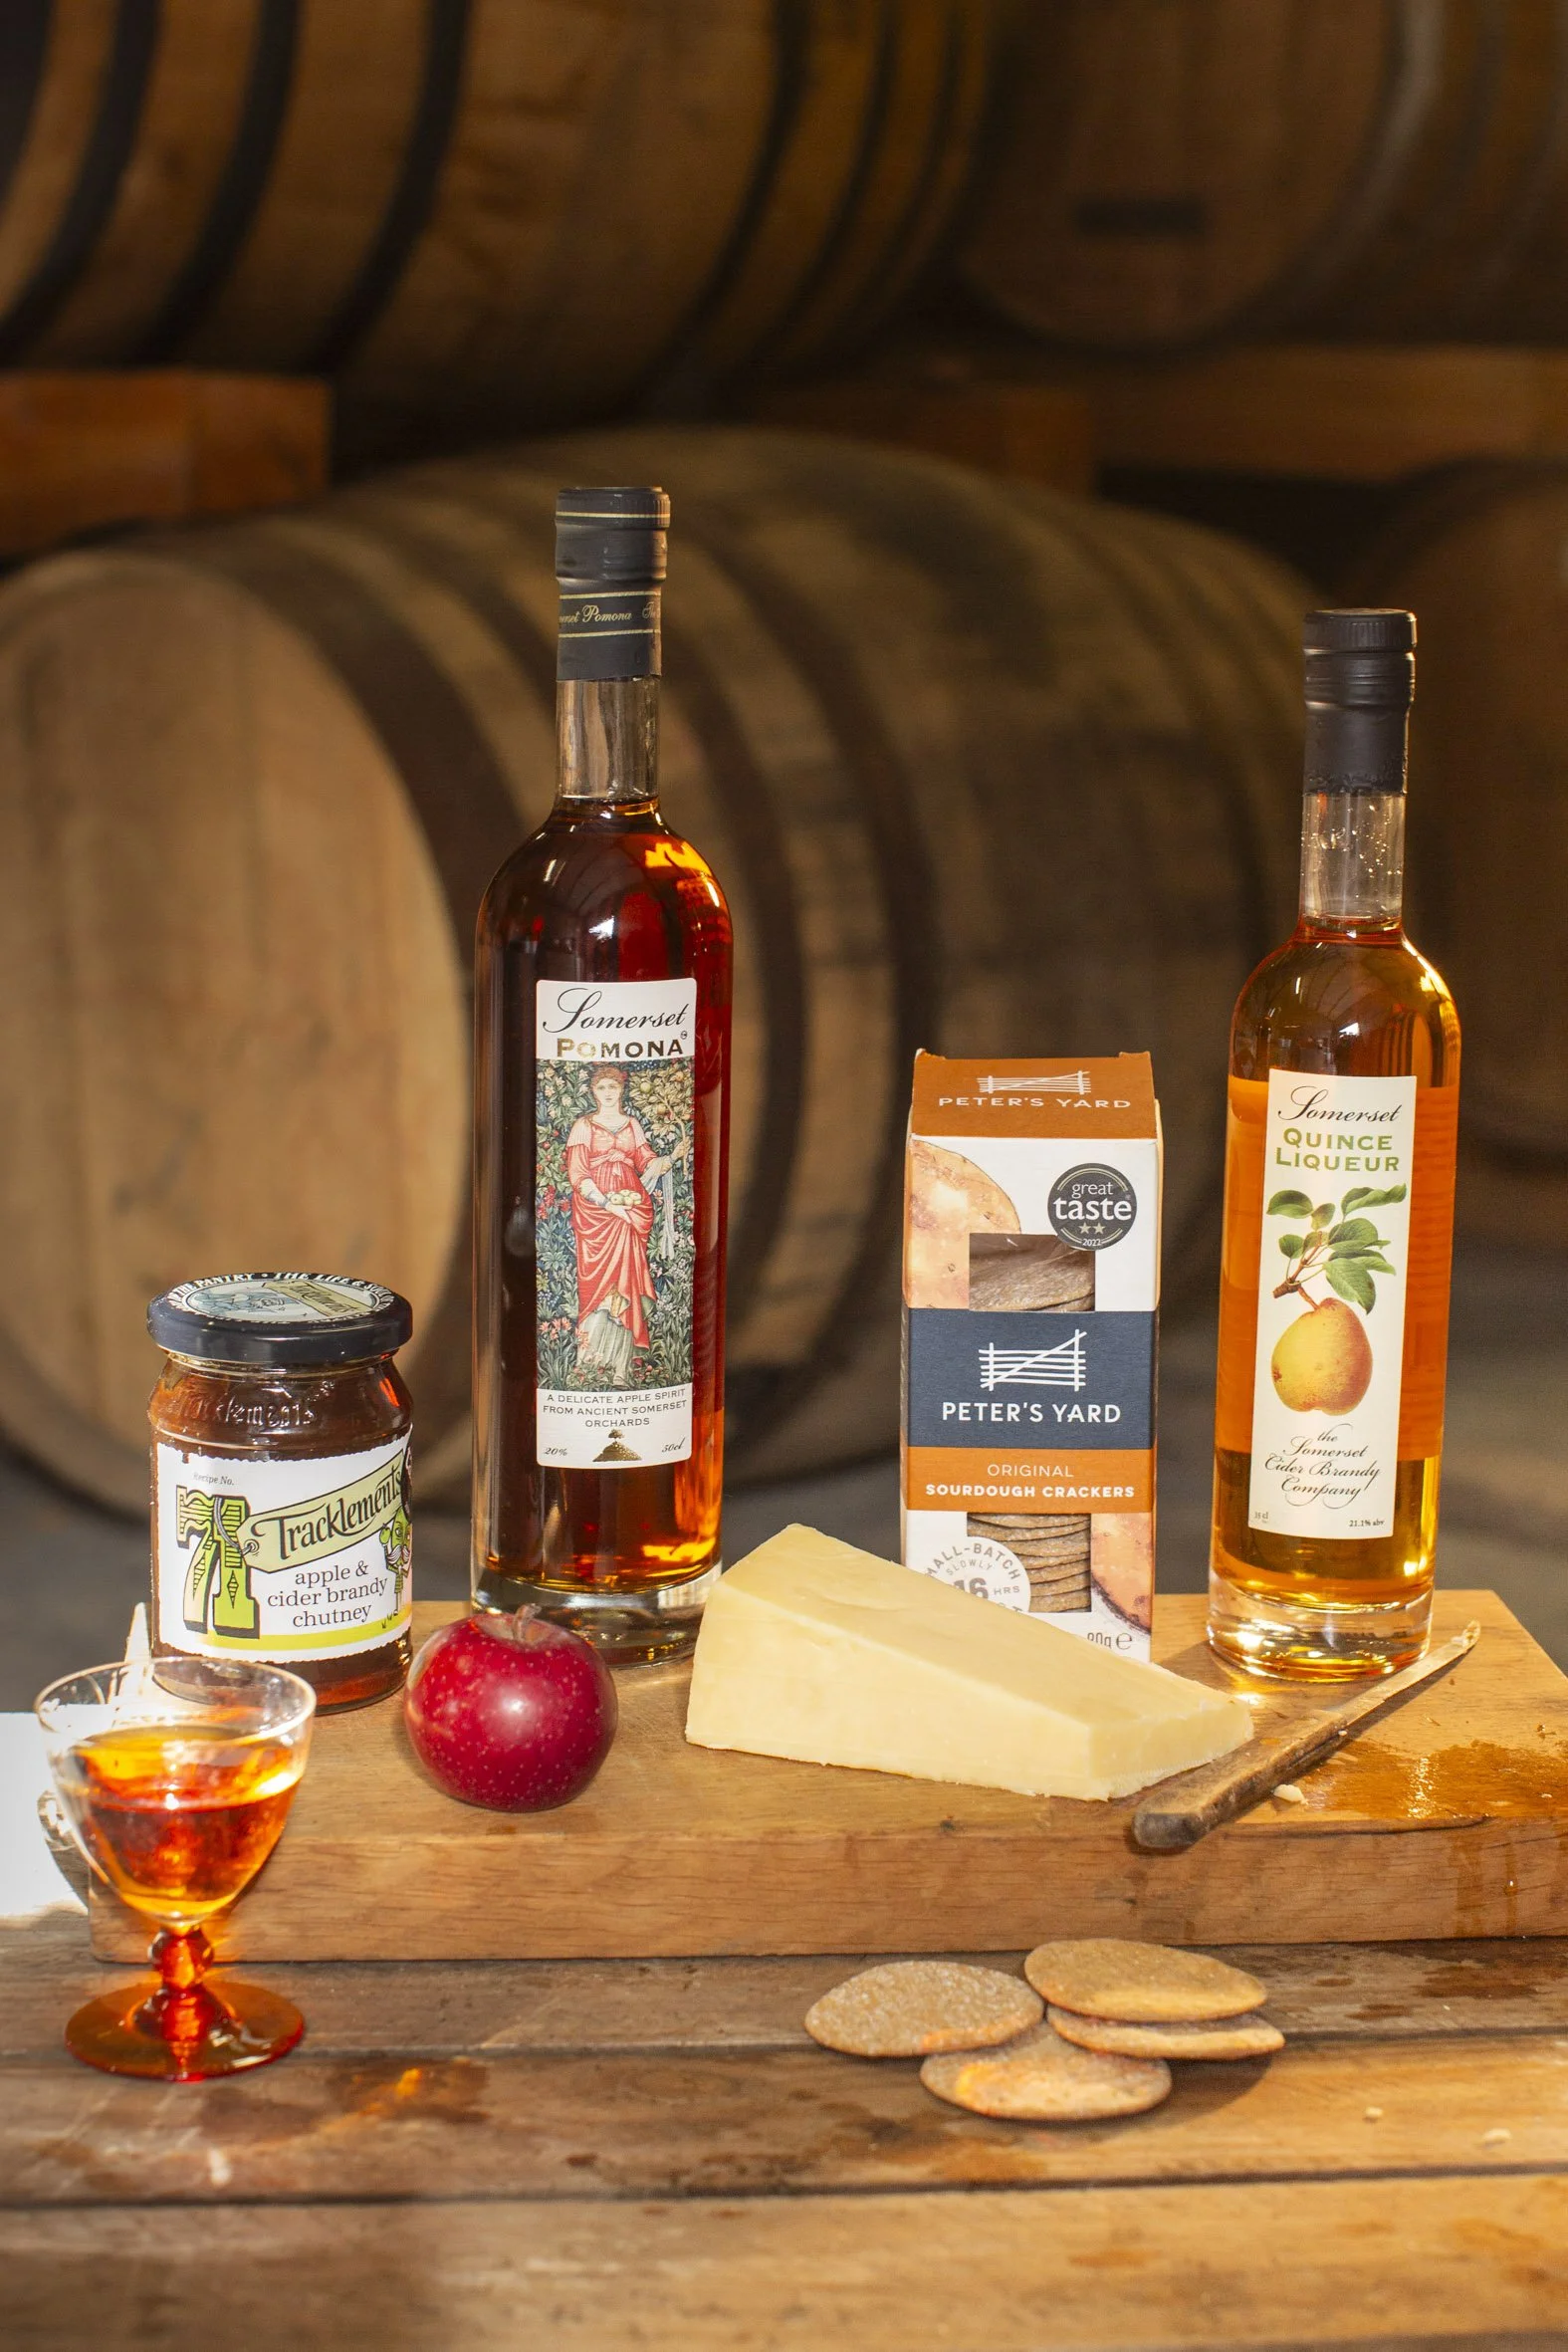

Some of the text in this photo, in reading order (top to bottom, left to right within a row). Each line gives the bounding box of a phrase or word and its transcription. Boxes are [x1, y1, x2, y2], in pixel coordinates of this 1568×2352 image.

[582, 604, 632, 623] Pomona
[543, 988, 689, 1033] Somerset
[557, 1039, 683, 1058] POMONA
[939, 1097, 1131, 1108] PETER'S YARD
[1278, 1085, 1403, 1122] Somerset
[1283, 1127, 1393, 1150] QUINCE
[1276, 1147, 1399, 1172] LIQUEUR
[1071, 1181, 1114, 1199] great
[1052, 1197, 1132, 1221] taste
[194, 1274, 255, 1288] PANTRY
[547, 1388, 686, 1404] A DELICATE APPLE SPIRIT
[543, 1399, 687, 1416] FROM ANCIENT SOMERSET
[942, 1401, 1121, 1423] PETER'S YARD
[584, 1417, 650, 1428] ORCHARDS
[1317, 1423, 1354, 1442] the
[545, 1447, 568, 1456] 20%
[1282, 1436, 1369, 1458] Somerset
[220, 1475, 235, 1486] No.
[987, 1464, 1074, 1478] ORIGINAL
[1264, 1453, 1382, 1491] Cider Brandy
[926, 1484, 1135, 1499] SOURDOUGH CRACKERS
[1281, 1475, 1363, 1510] Company
[251, 1465, 402, 1560] Tracklements
[295, 1559, 369, 1590] apple &
[946, 1558, 993, 1575] SLOWLY
[267, 1577, 388, 1607] cider brandy
[994, 1585, 1020, 1595] HRS
[293, 1603, 372, 1628] chutney
